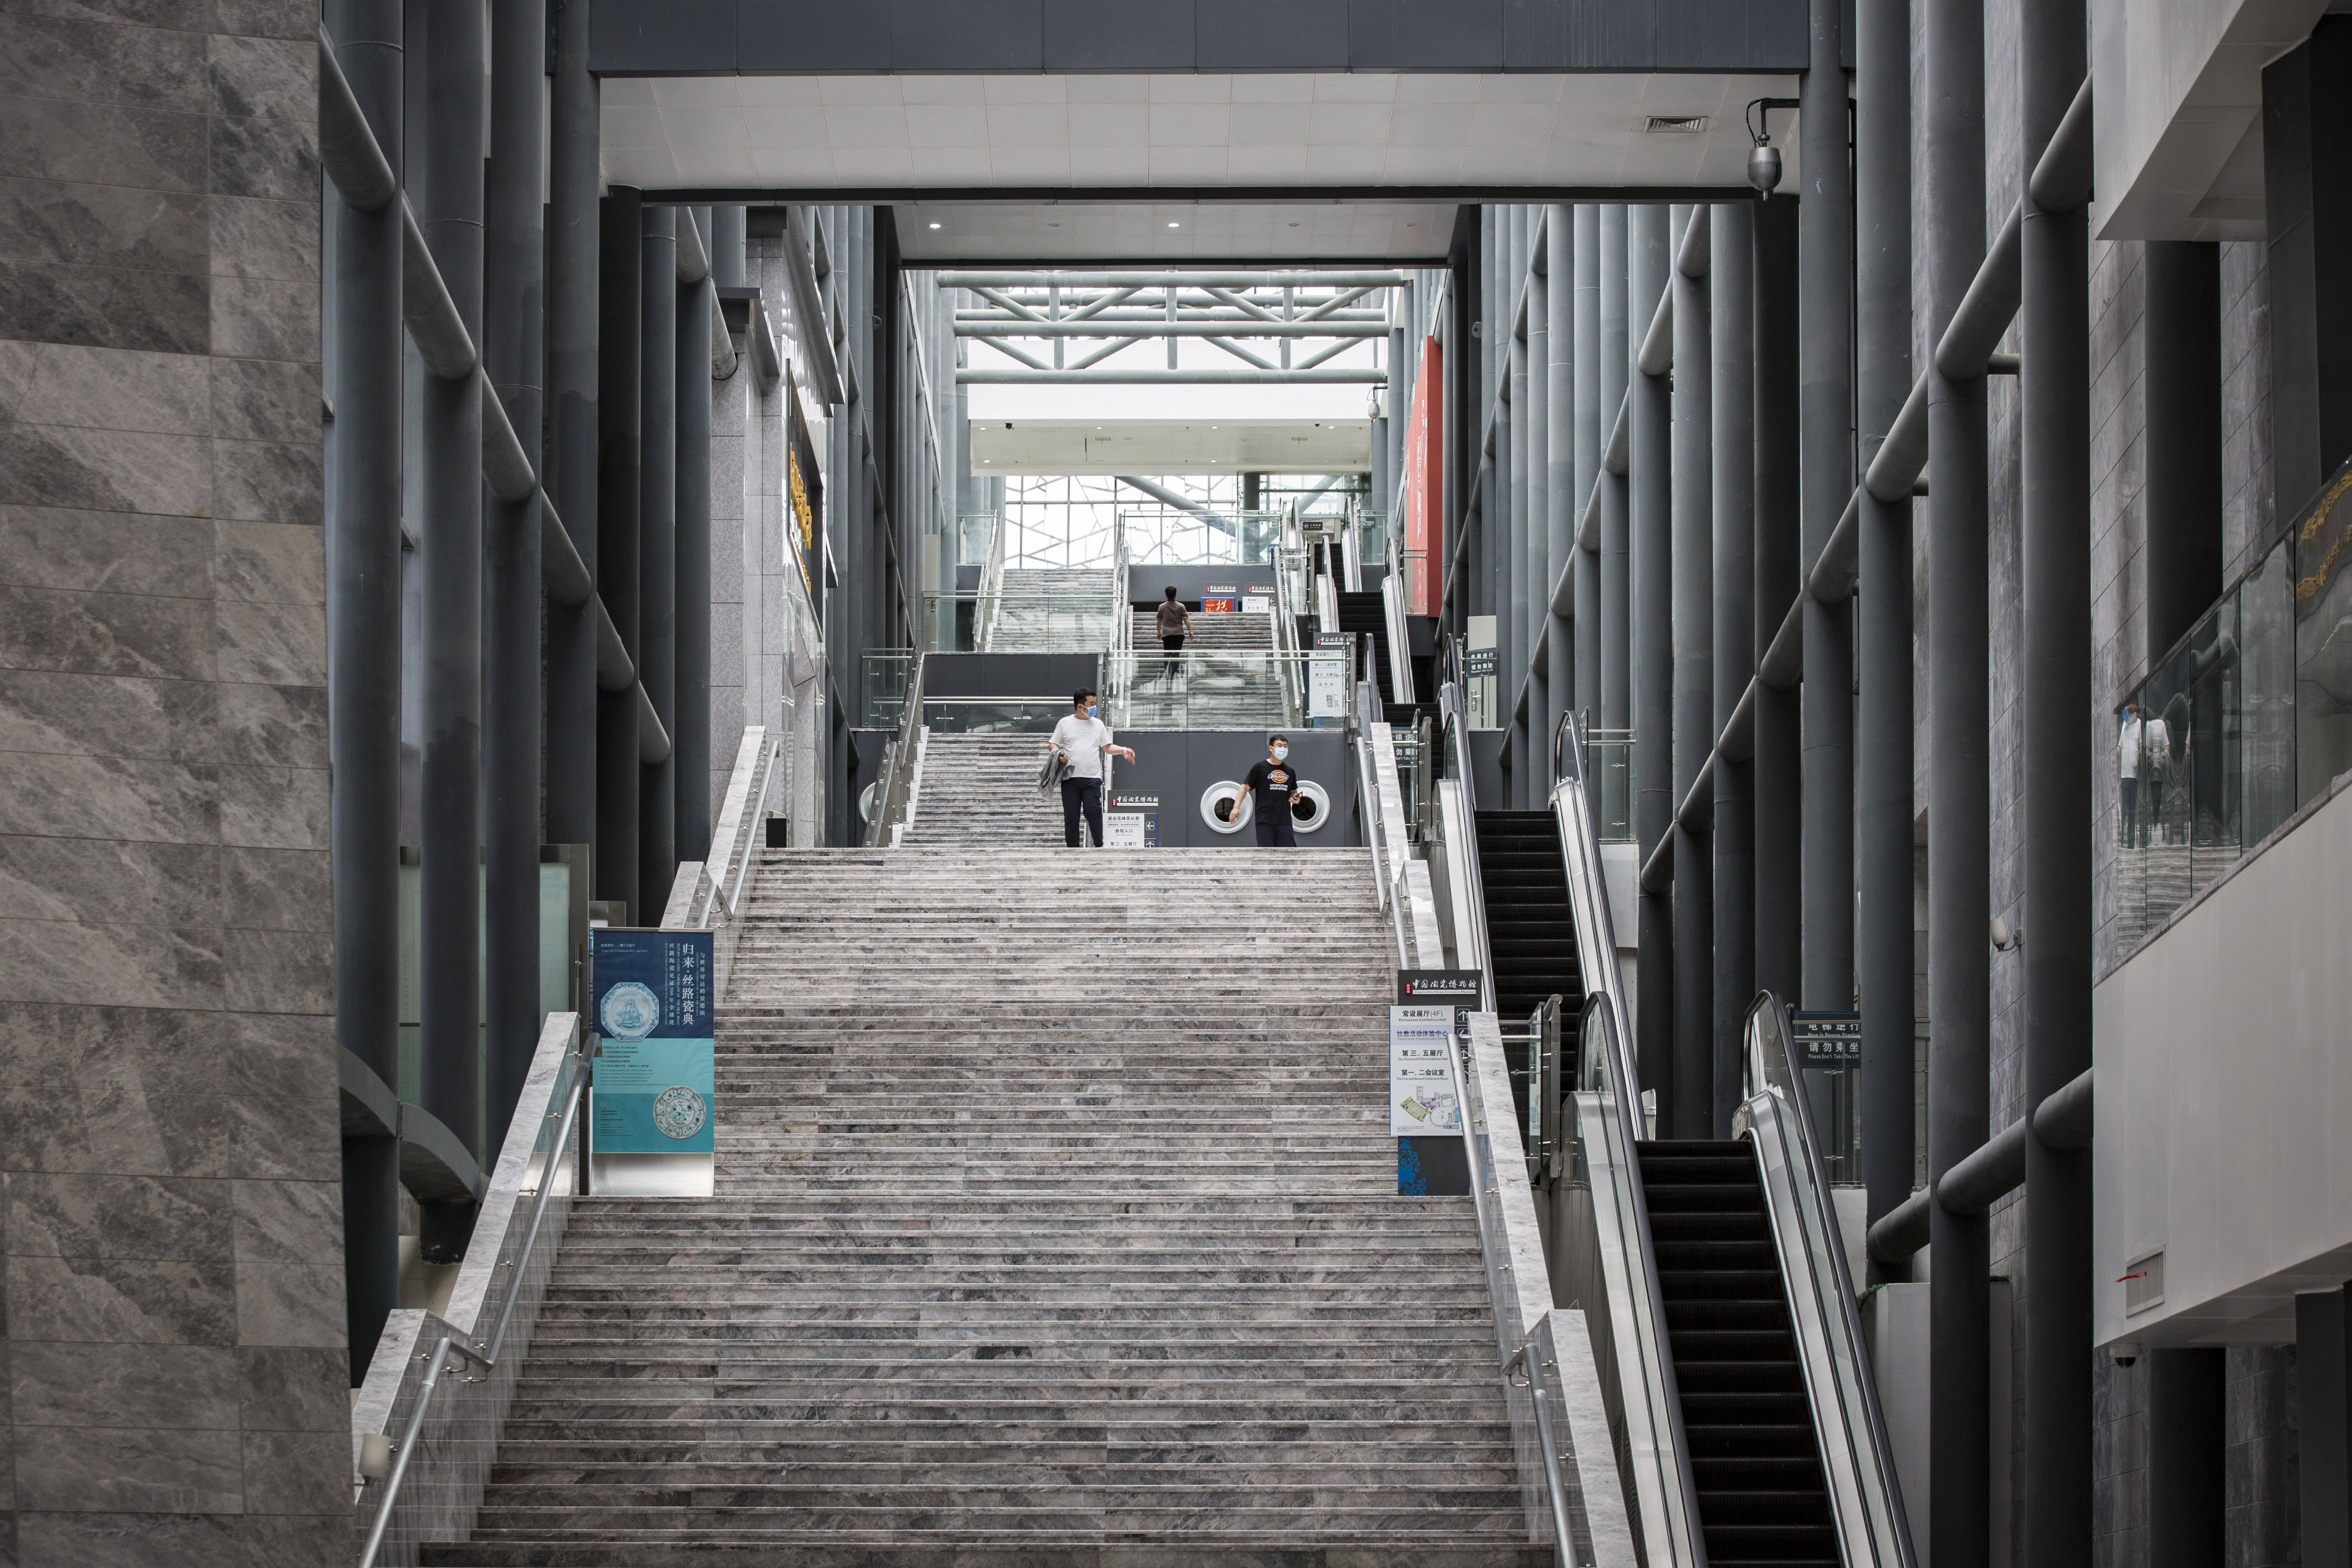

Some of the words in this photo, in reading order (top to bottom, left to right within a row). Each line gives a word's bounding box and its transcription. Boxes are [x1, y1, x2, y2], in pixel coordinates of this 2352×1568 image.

[682, 943, 694, 1025] 归来·丝路瓷典
[1412, 979, 1477, 989] 中国陶瓷博物馆
[1809, 1042, 1859, 1052] 请勿乘坐
